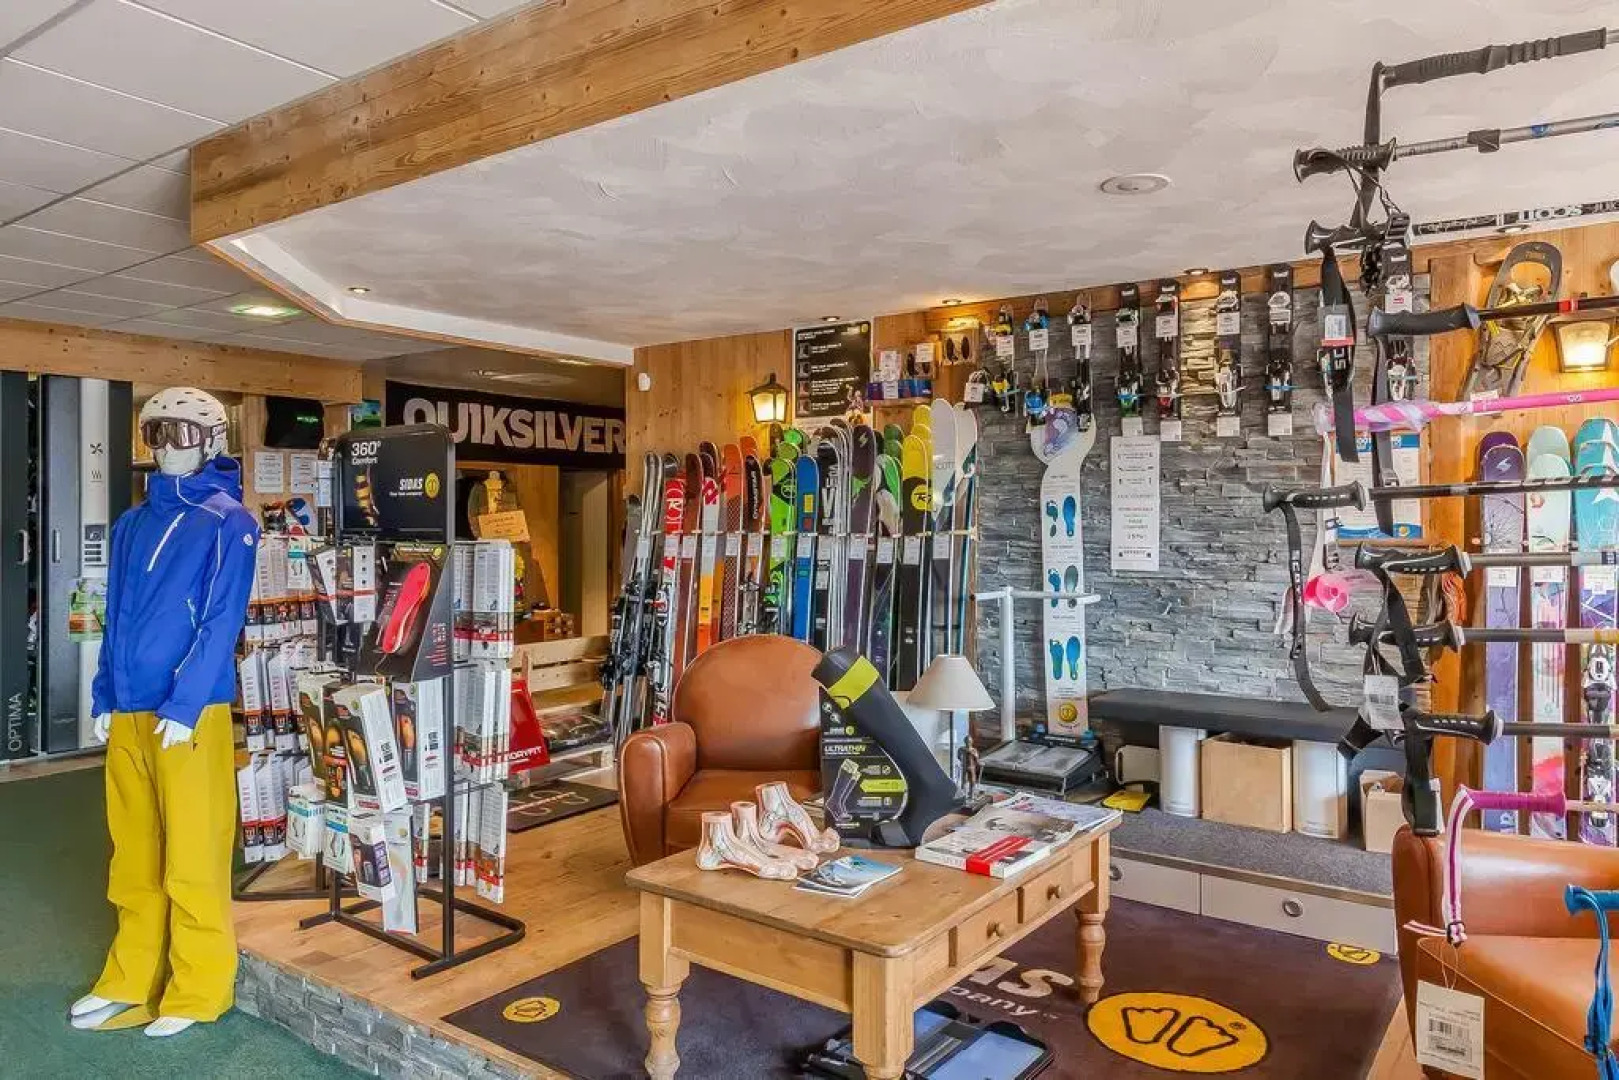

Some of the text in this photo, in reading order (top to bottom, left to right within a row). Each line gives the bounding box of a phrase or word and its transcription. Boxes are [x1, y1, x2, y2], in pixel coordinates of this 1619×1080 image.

[403, 398, 626, 454] QUIKSILVER
[351, 440, 381, 456] 360°
[400, 478, 423, 491] SIDAS
[7, 692, 23, 752] OPTIMA
